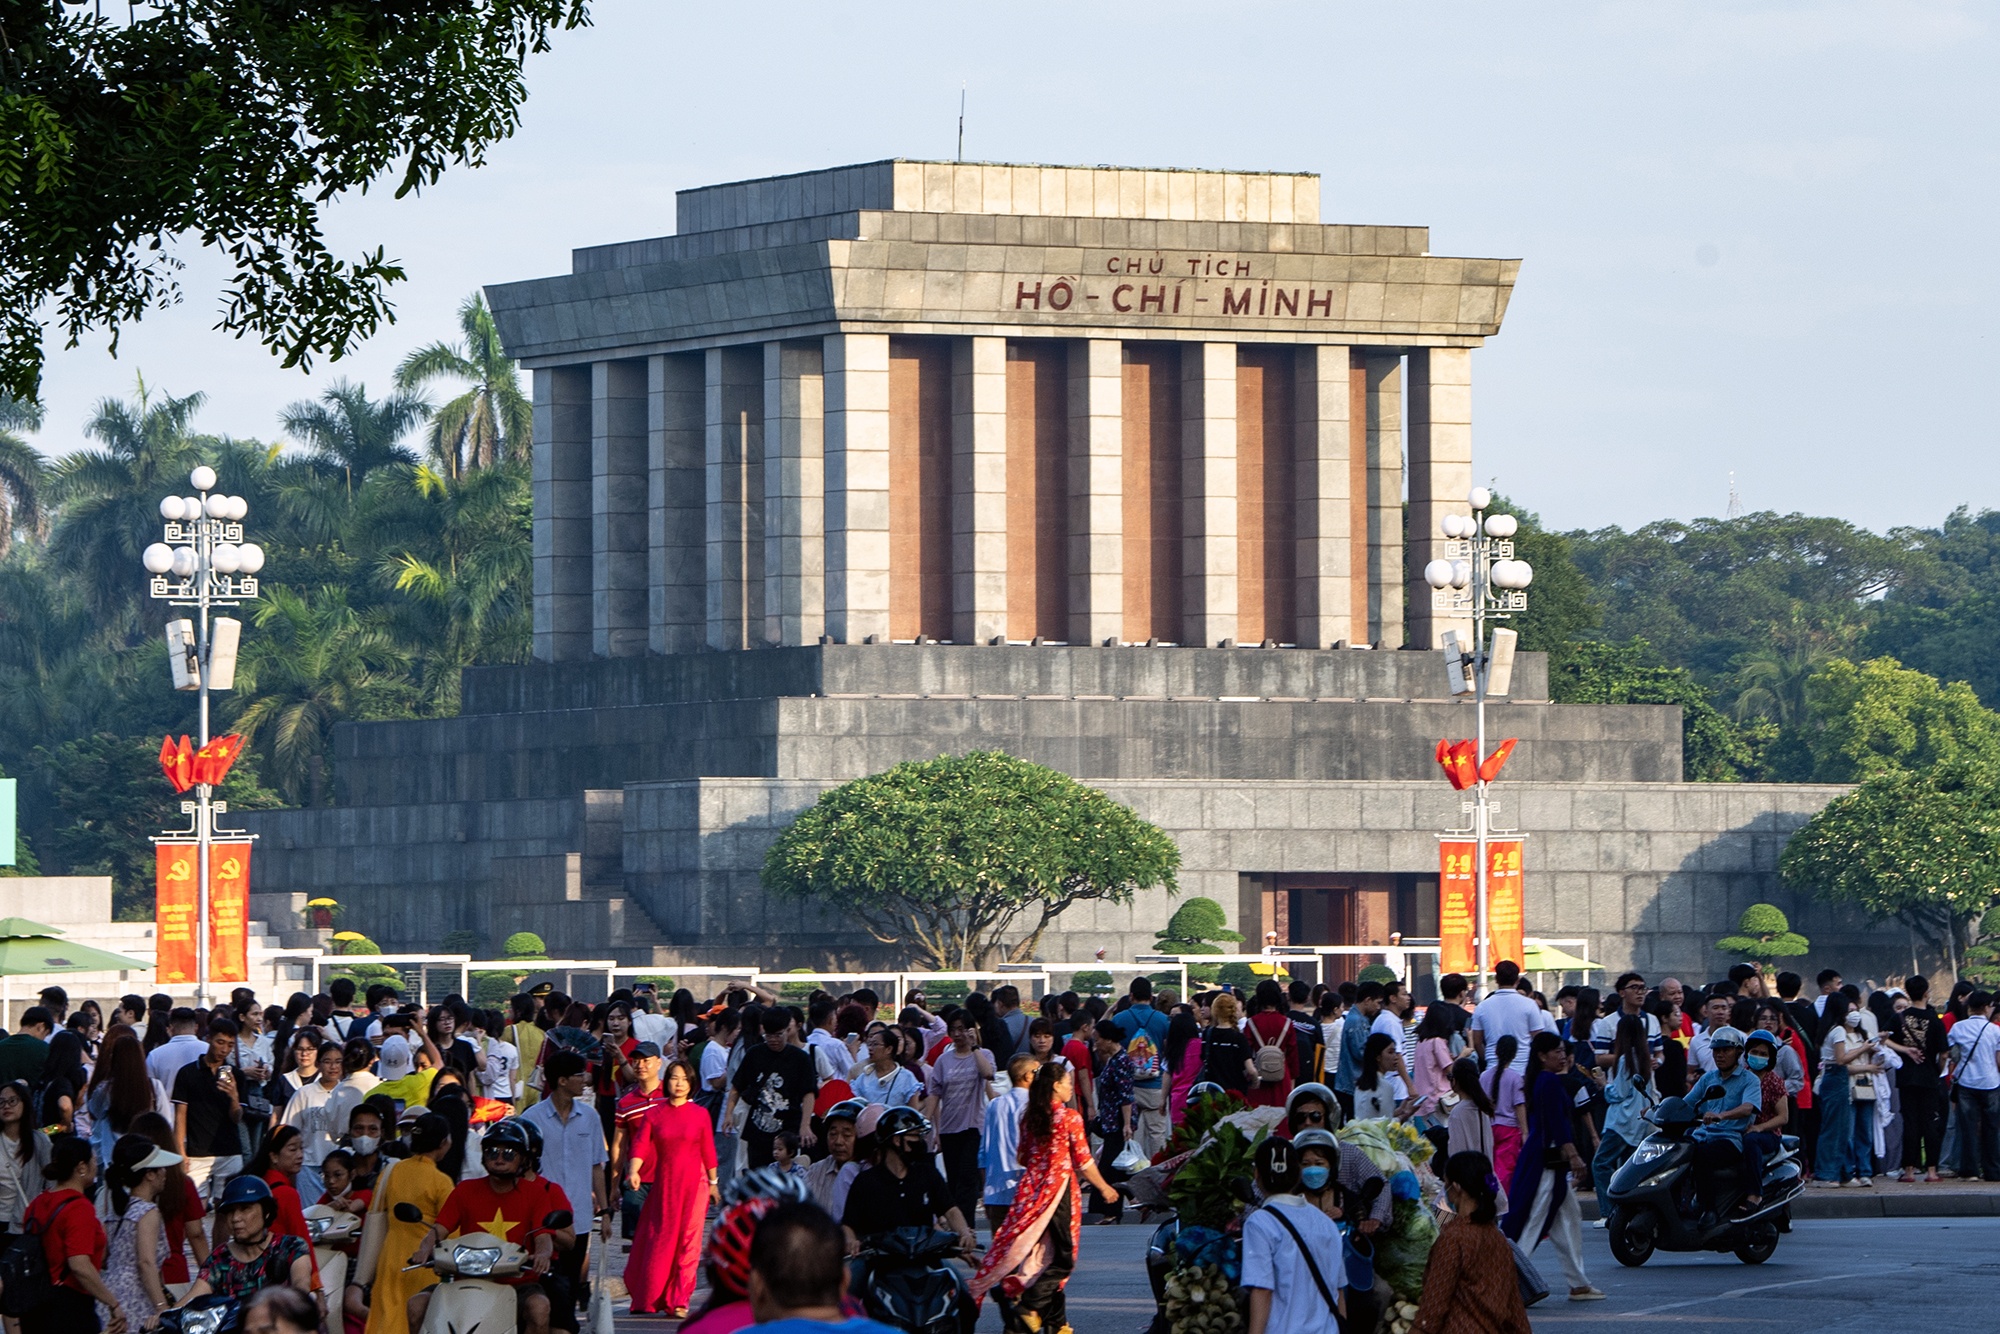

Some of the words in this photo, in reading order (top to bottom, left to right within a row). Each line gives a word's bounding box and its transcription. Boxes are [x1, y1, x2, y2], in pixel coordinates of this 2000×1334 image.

[1107, 251, 1164, 274] CHỦ
[1187, 254, 1251, 282] TỊCH
[1015, 275, 1077, 311] HỒ
[1112, 279, 1187, 313] CHÍ
[1222, 279, 1333, 317] MINH
[1446, 854, 1471, 873] 2-9
[1493, 851, 1519, 870] 2-9
